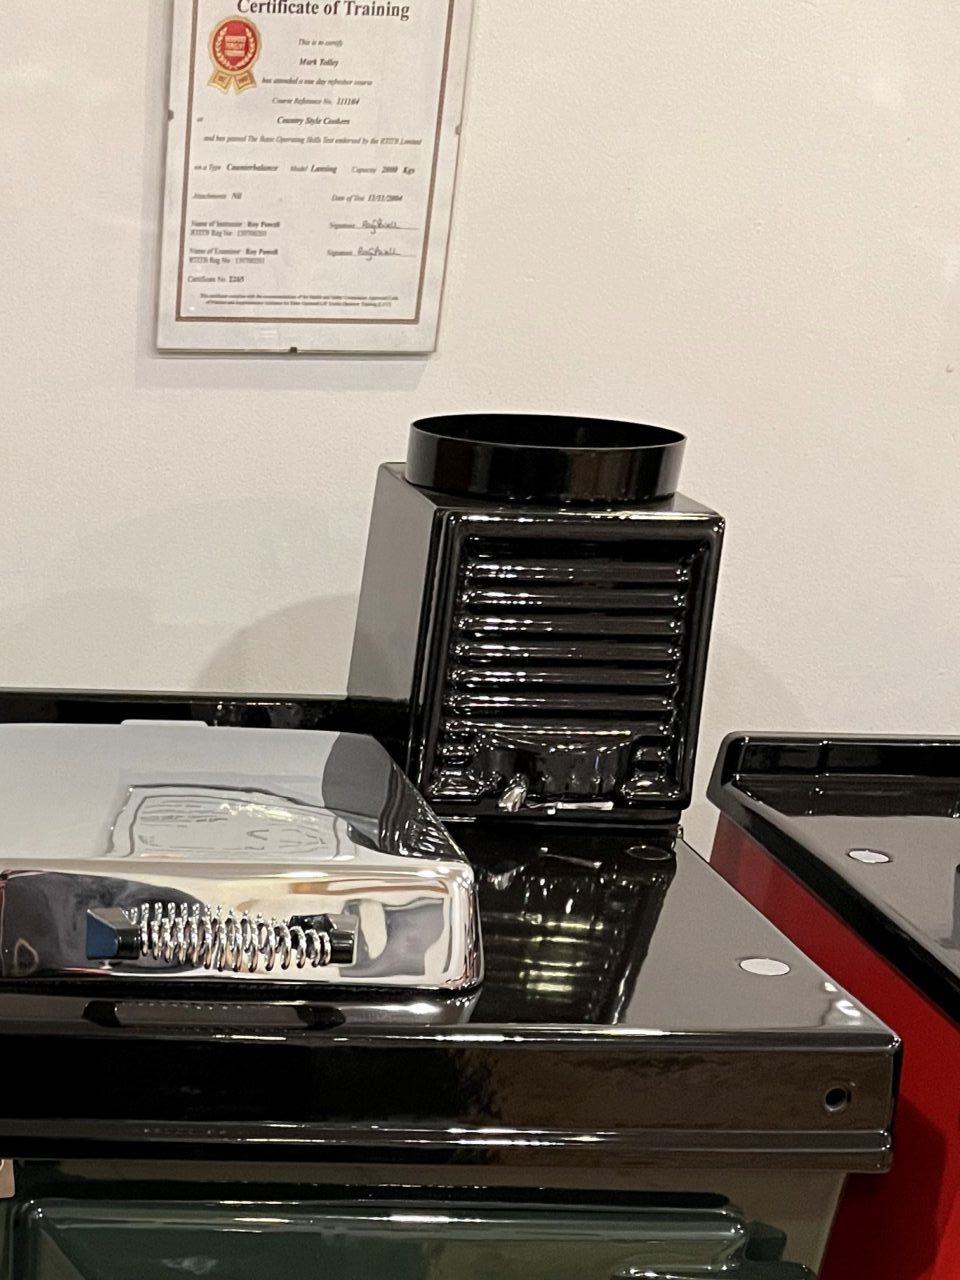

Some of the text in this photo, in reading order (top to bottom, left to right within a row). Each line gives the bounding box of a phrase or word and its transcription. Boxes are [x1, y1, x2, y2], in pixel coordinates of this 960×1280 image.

[237, 0, 410, 21] Certificate of Training
[299, 58, 317, 66] Mark
